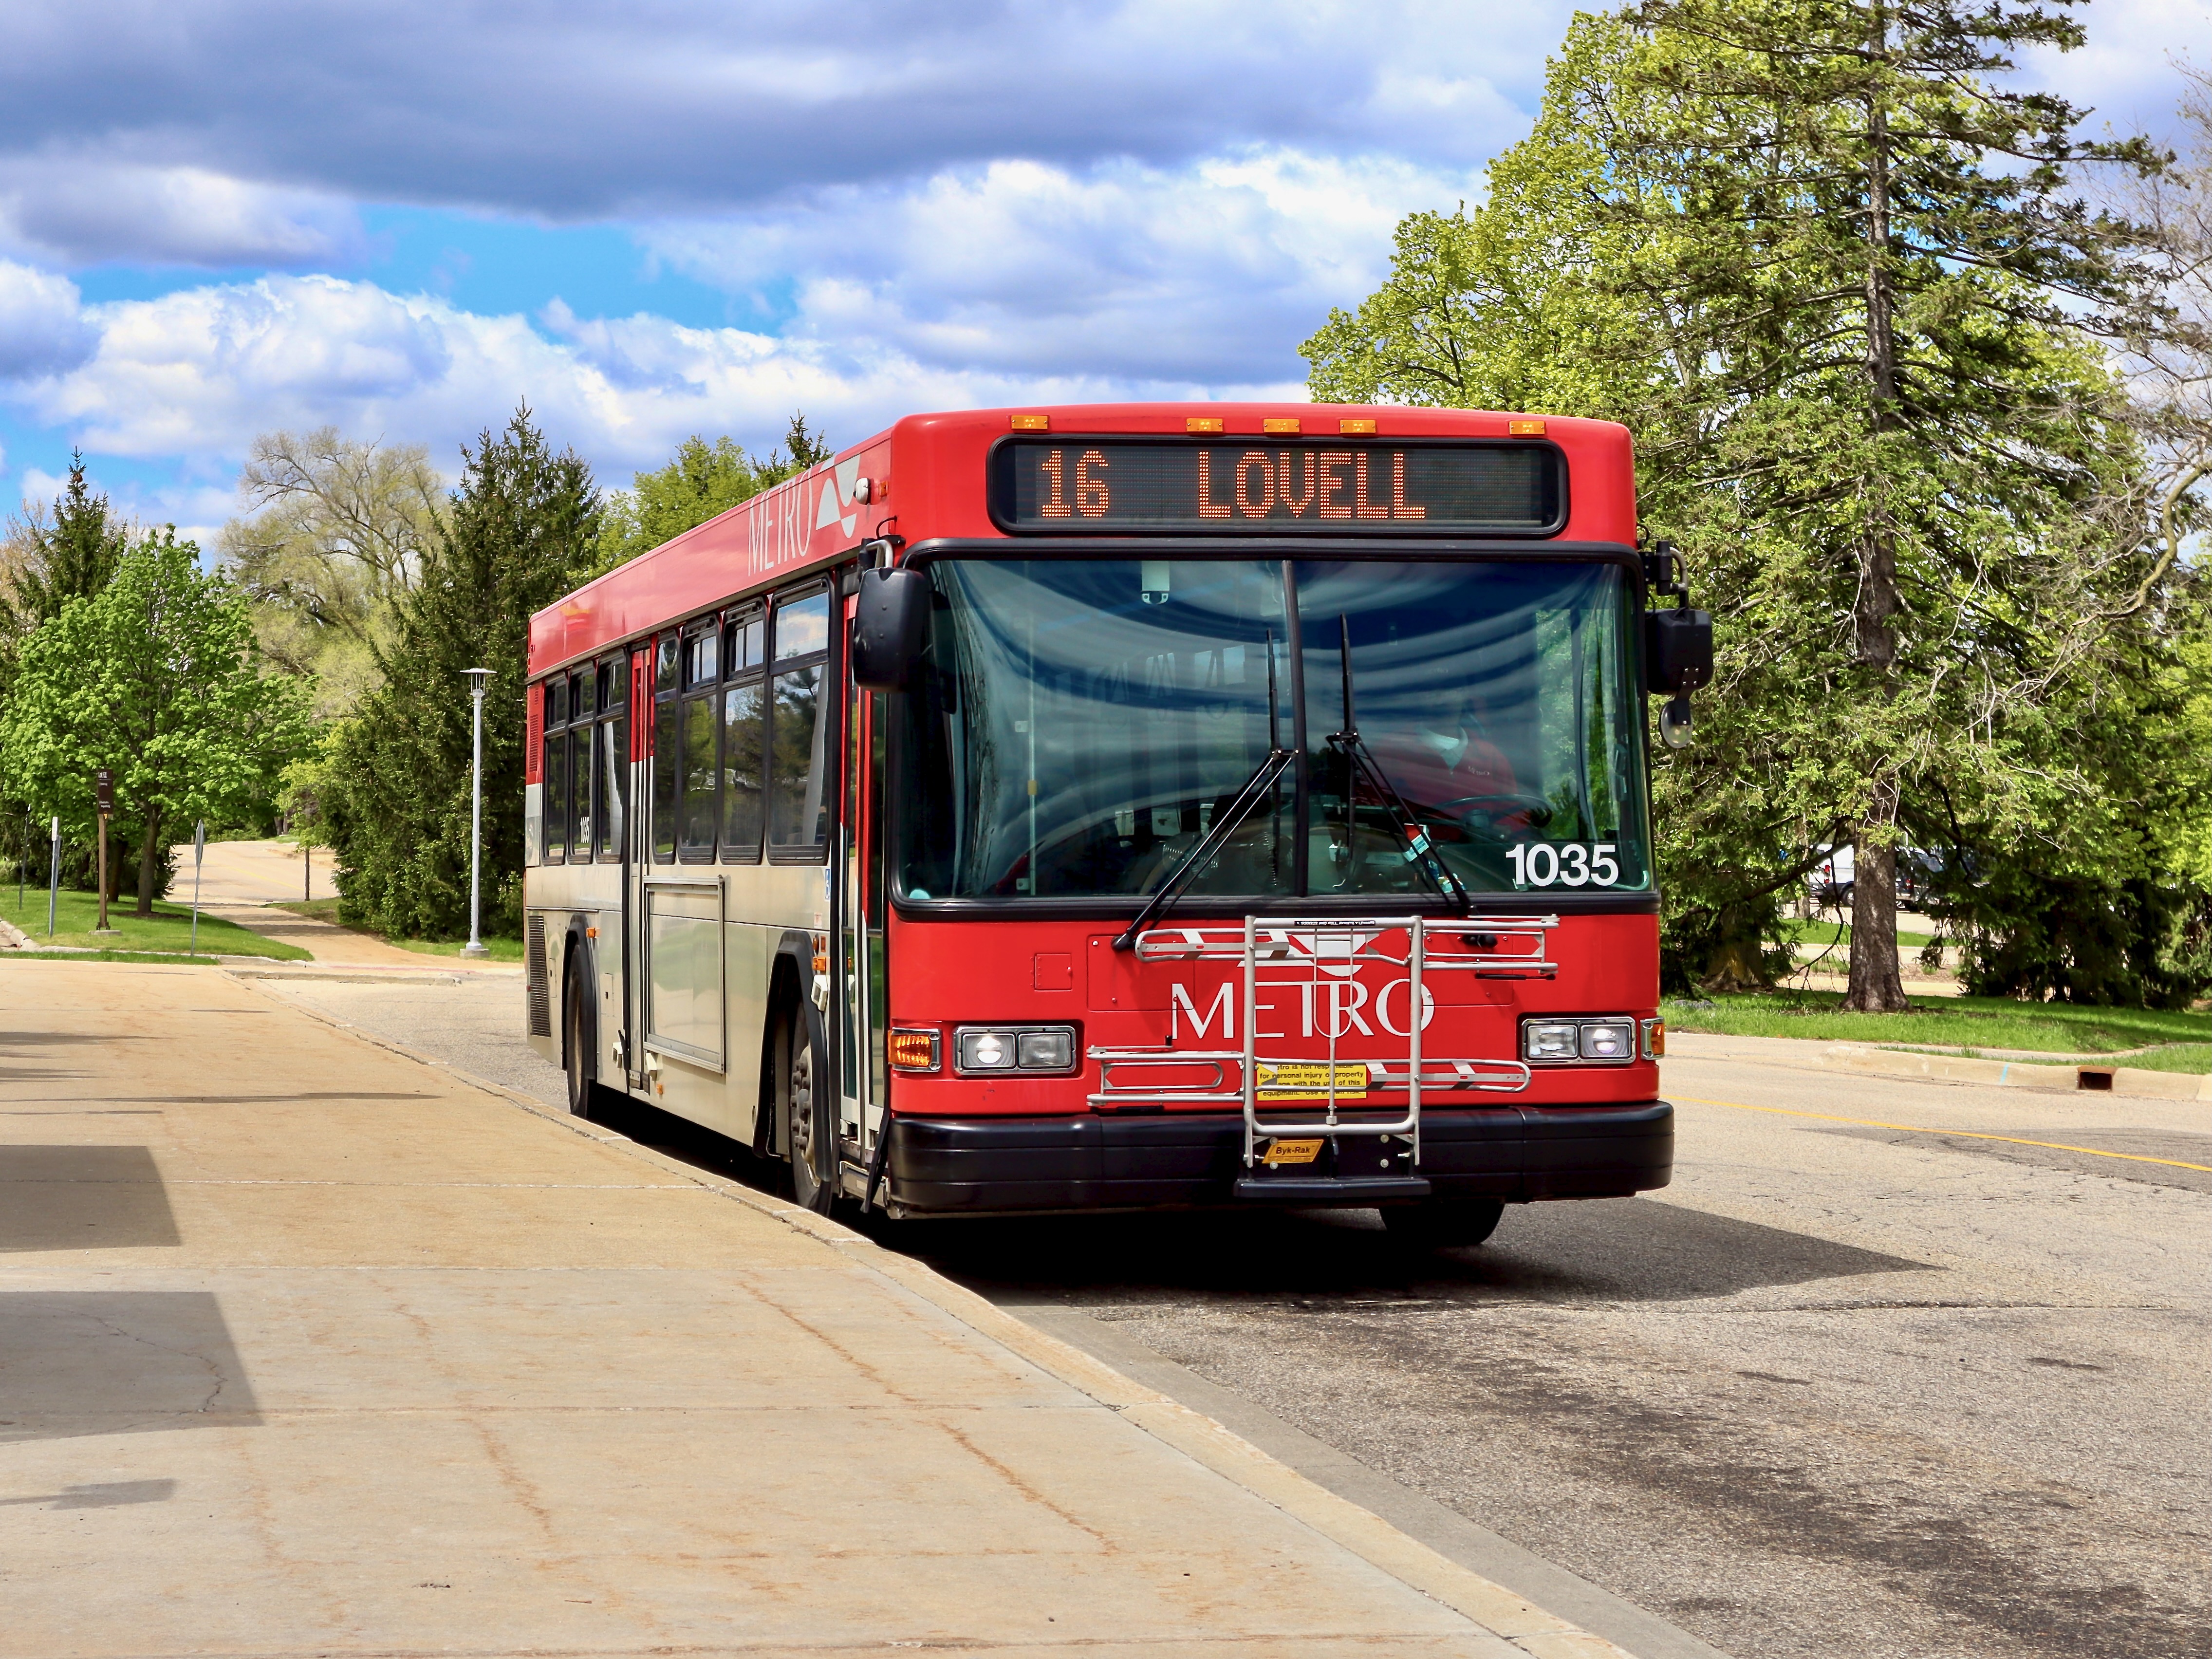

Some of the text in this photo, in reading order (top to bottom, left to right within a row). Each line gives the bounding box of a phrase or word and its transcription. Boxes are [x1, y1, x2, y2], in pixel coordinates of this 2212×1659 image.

[1041, 450, 1426, 520] 16 LOVELL
[748, 466, 813, 577] METRO
[580, 817, 590, 843] 1035
[1506, 843, 1619, 886] 1035
[1171, 978, 1435, 1039] METRO
[1276, 1146, 1311, 1156] Byk-Rak
